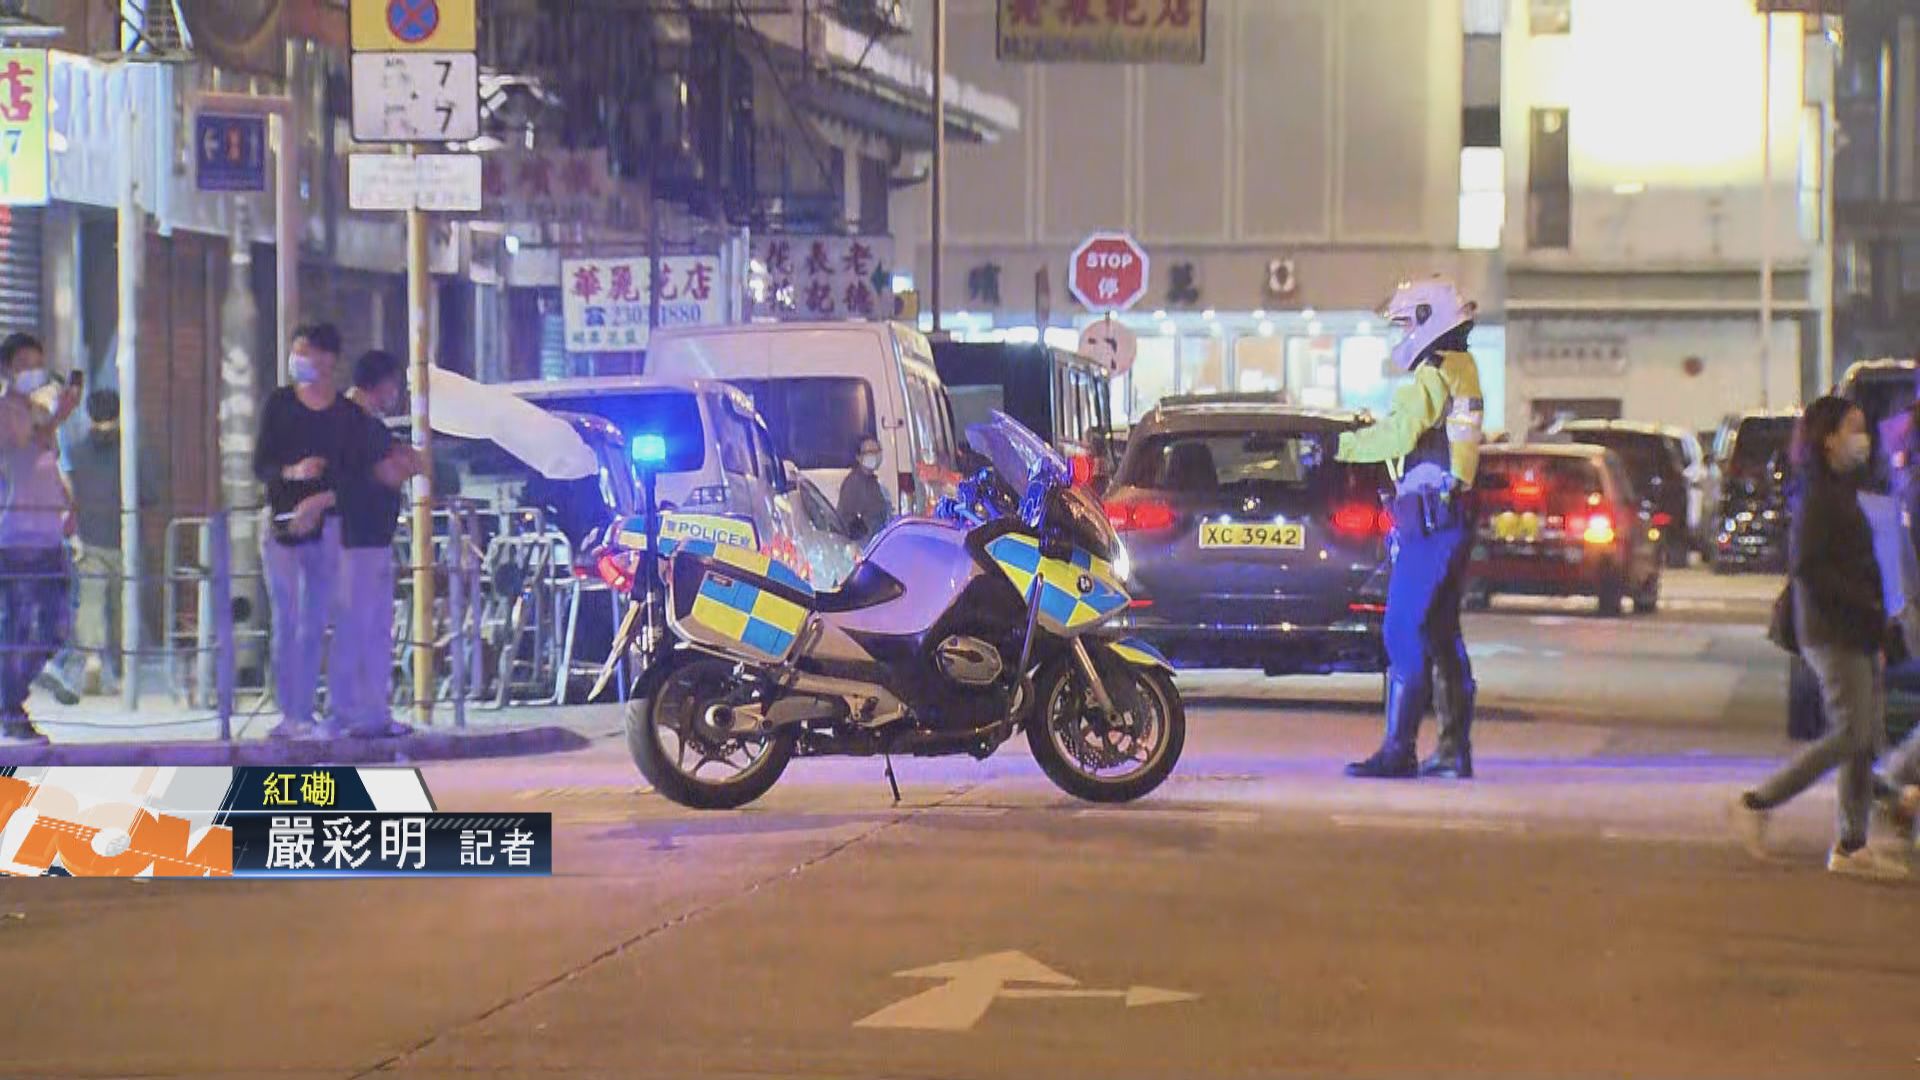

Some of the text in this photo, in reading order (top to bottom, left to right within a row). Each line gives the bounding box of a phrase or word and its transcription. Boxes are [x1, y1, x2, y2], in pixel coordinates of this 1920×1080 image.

[1086, 253, 1133, 269] STOP
[1097, 277, 1120, 299] 停
[678, 521, 740, 546] POLICE
[1207, 528, 1297, 545] XC 3942
